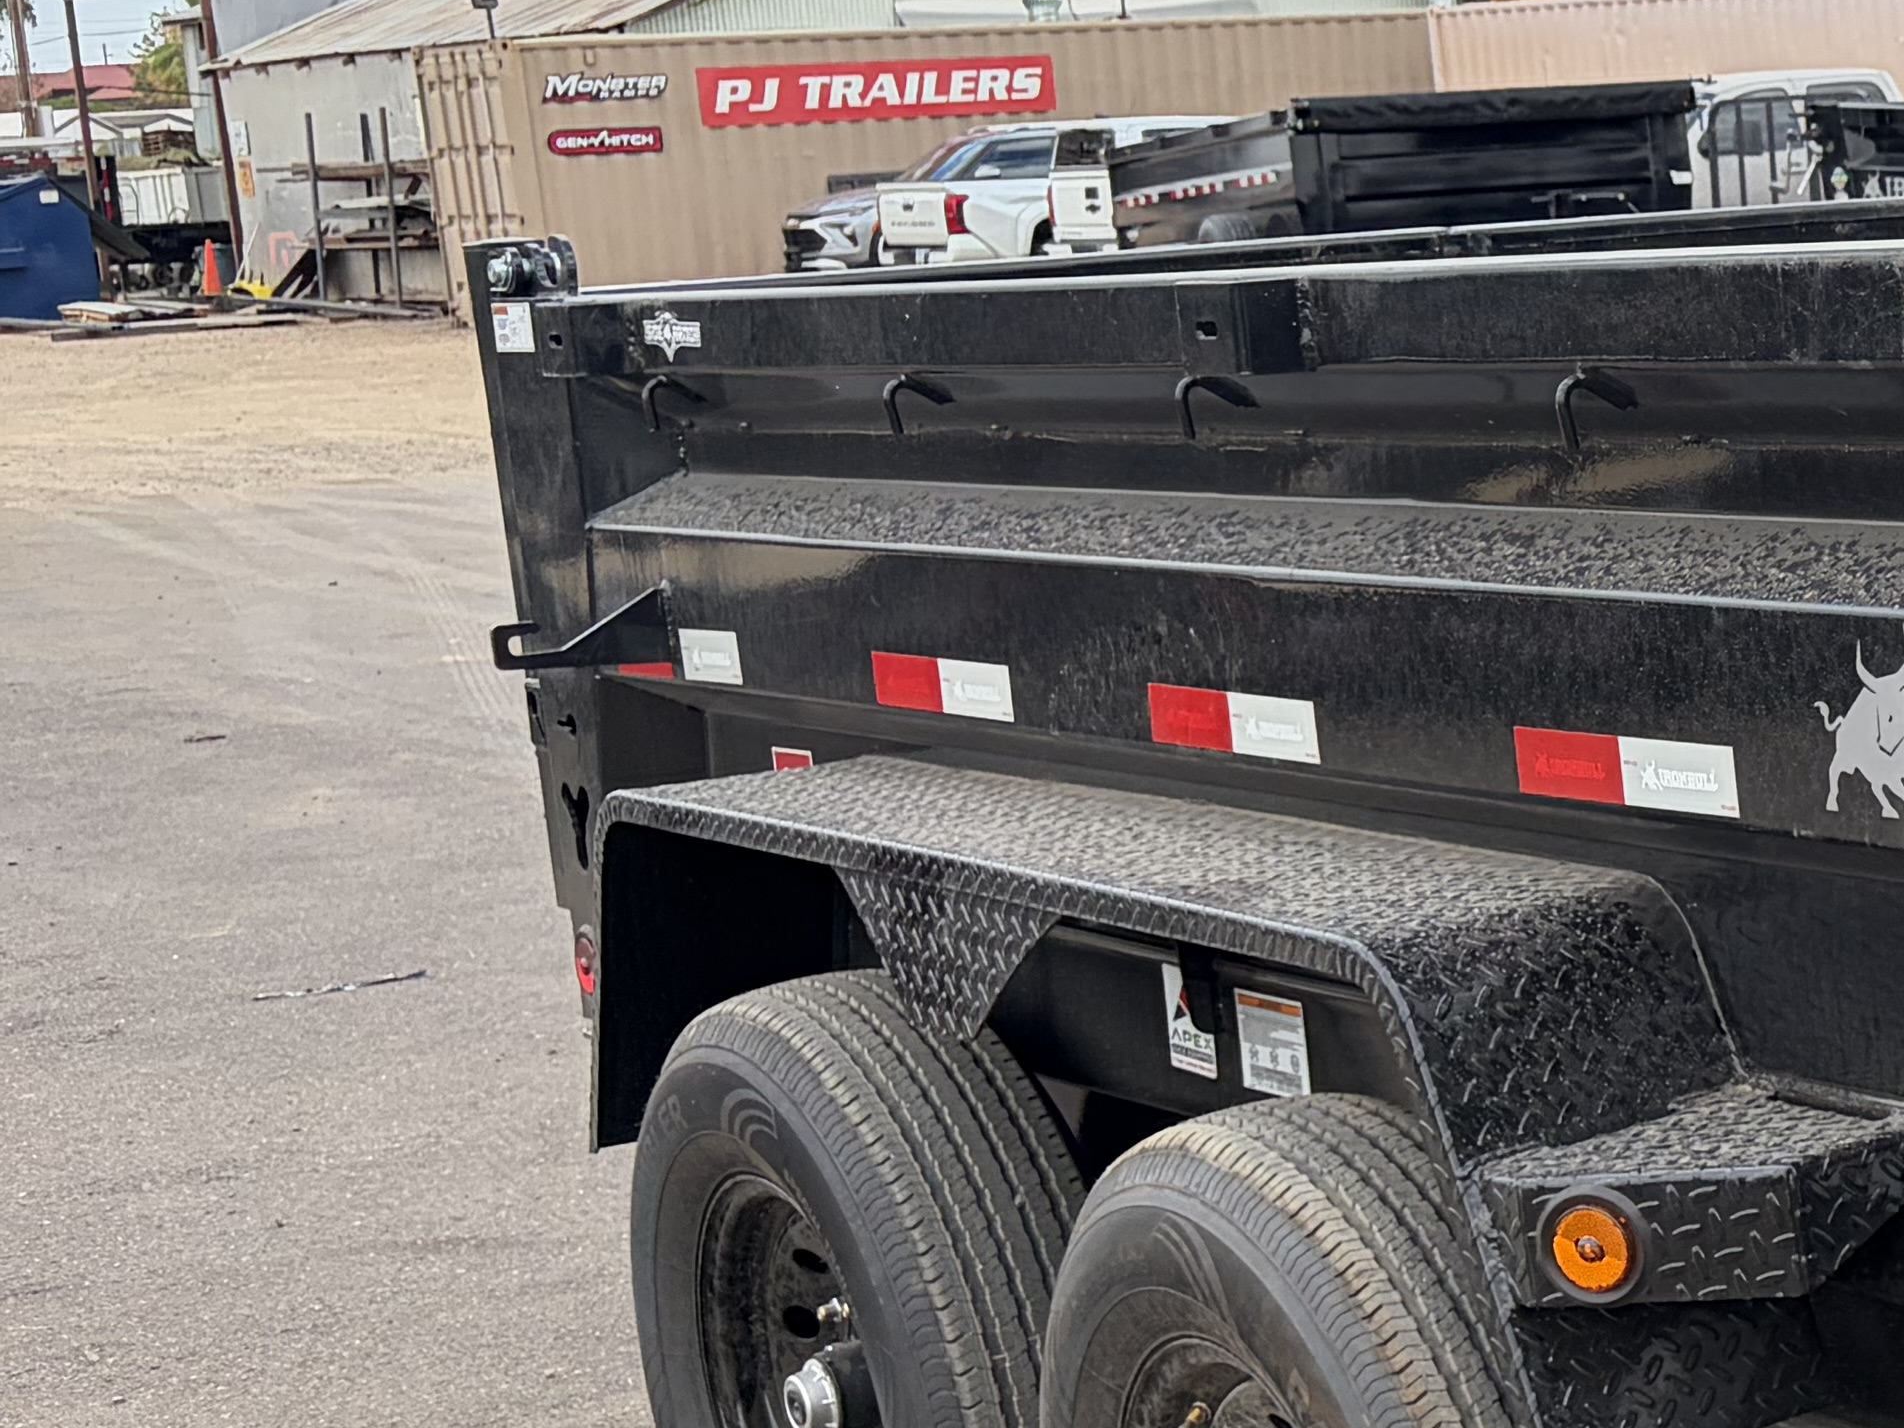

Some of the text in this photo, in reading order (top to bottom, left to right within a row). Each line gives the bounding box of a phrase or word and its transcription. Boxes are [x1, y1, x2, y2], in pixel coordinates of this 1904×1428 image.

[715, 67, 1042, 114] PJ TRAILERS
[605, 133, 654, 147] HITCH
[1171, 1026, 1214, 1052] APEX
